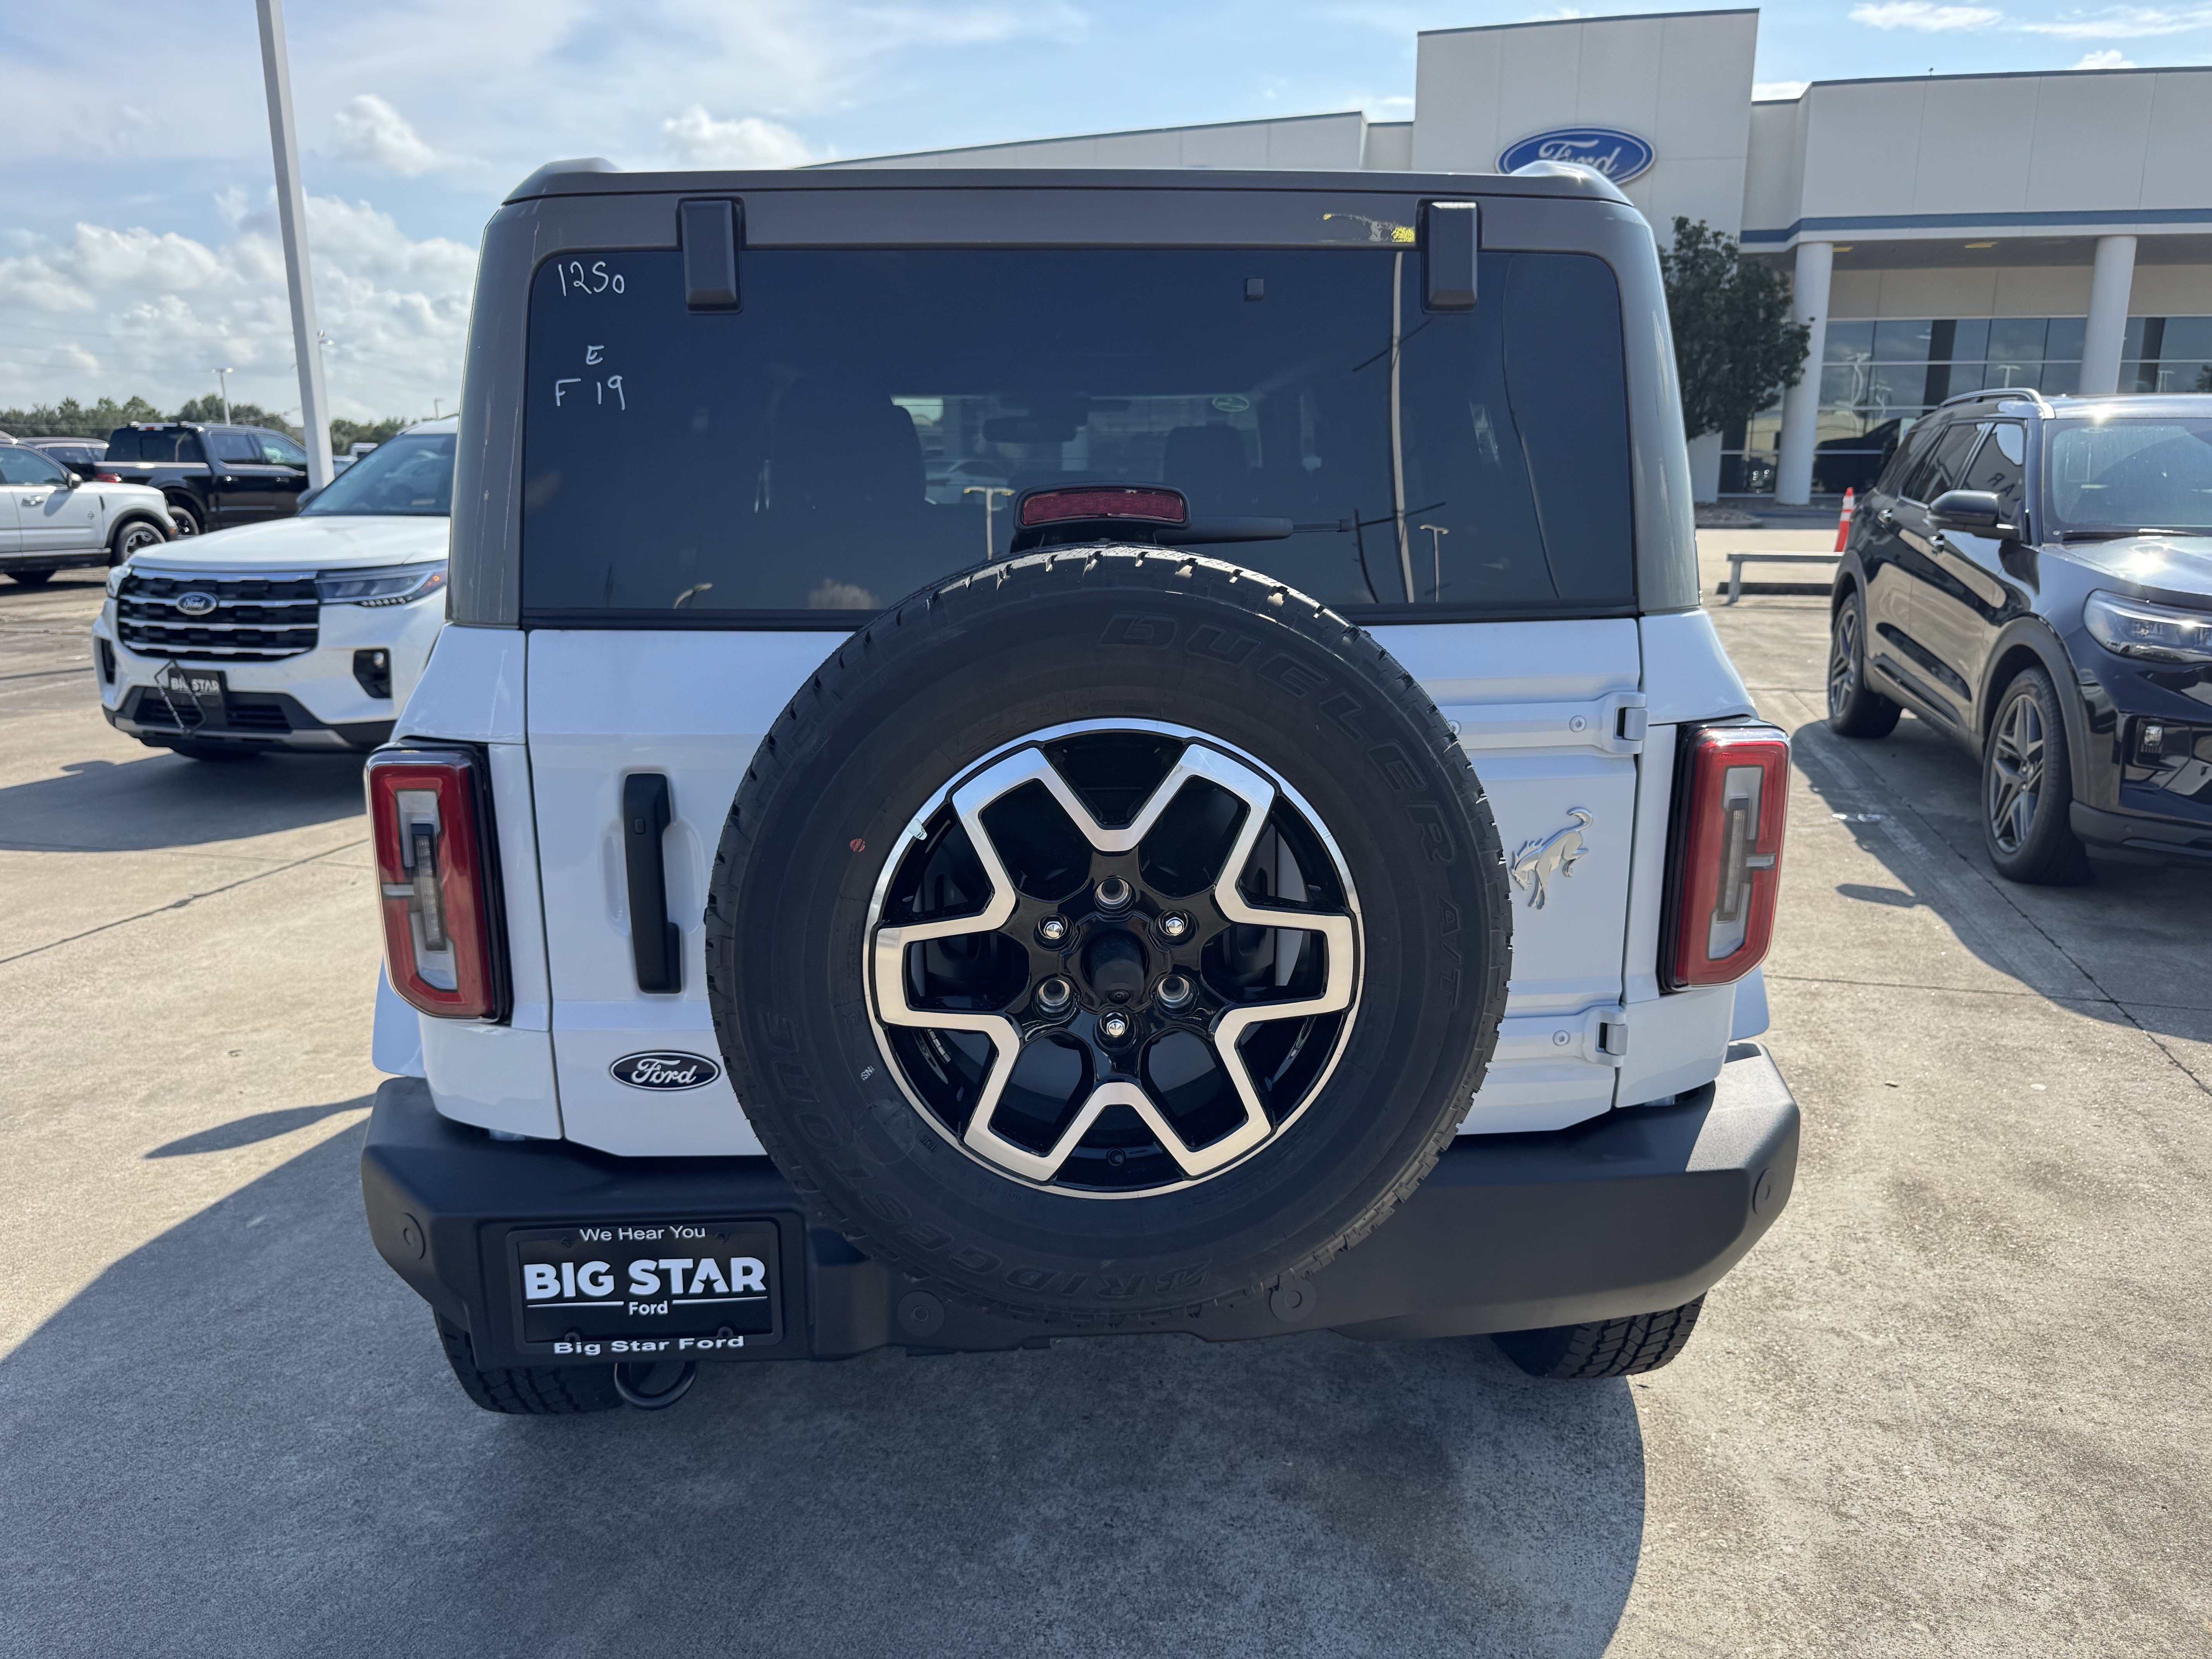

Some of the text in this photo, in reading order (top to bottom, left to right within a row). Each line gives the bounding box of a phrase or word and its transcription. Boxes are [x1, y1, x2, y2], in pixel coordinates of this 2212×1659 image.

[585, 345, 605, 366] E
[192, 678, 220, 693] STAR
[1096, 612, 1463, 1011] DUELER A/T
[630, 1058, 698, 1084] Ford
[760, 1008, 1212, 1299] BRIDGESTONE
[580, 1226, 706, 1242] We Hear You
[524, 1257, 766, 1299] BIG STAR
[629, 1300, 668, 1316] Ford
[554, 1336, 744, 1356] Big Star Ford
